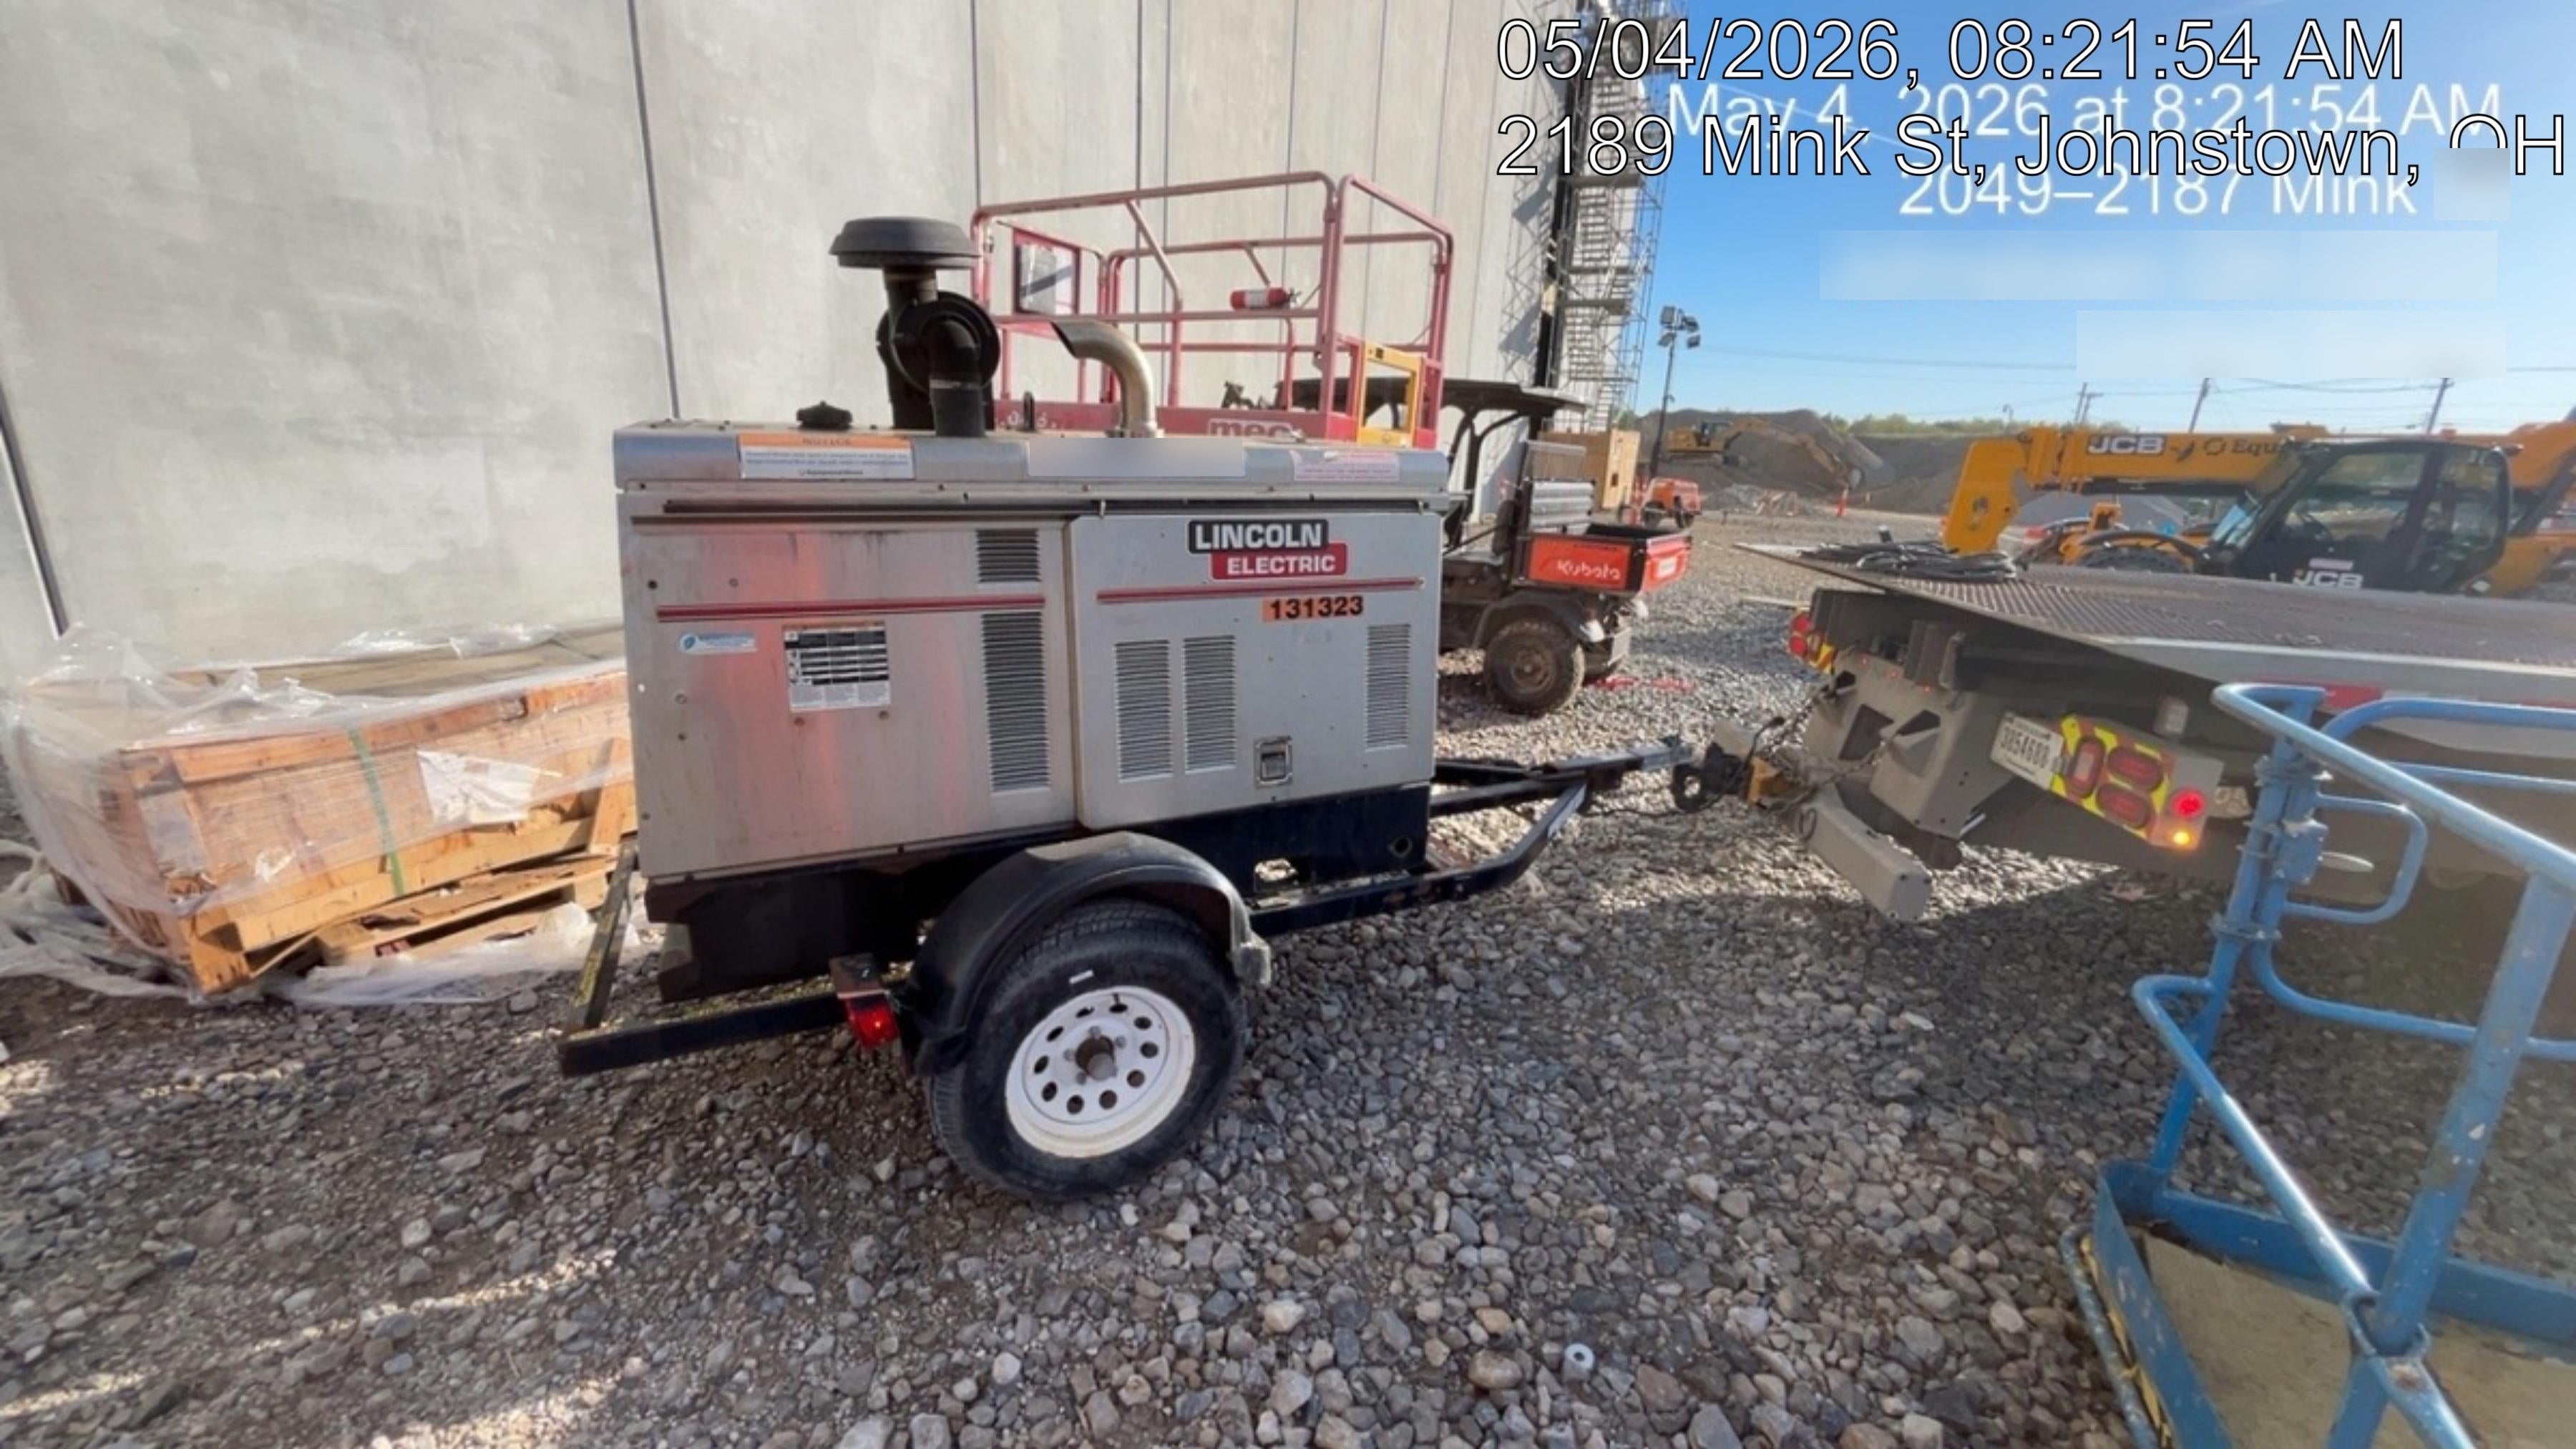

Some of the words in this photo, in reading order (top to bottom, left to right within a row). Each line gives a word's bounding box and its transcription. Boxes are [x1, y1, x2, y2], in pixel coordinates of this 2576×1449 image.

[2087, 435, 2165, 454] JCB
[1195, 523, 1322, 550] LINCOLN
[1227, 555, 1336, 575] ELECTRIC
[1557, 560, 1621, 580] Kubota
[2292, 570, 2363, 588] JCB
[1269, 595, 1364, 620] 131323
